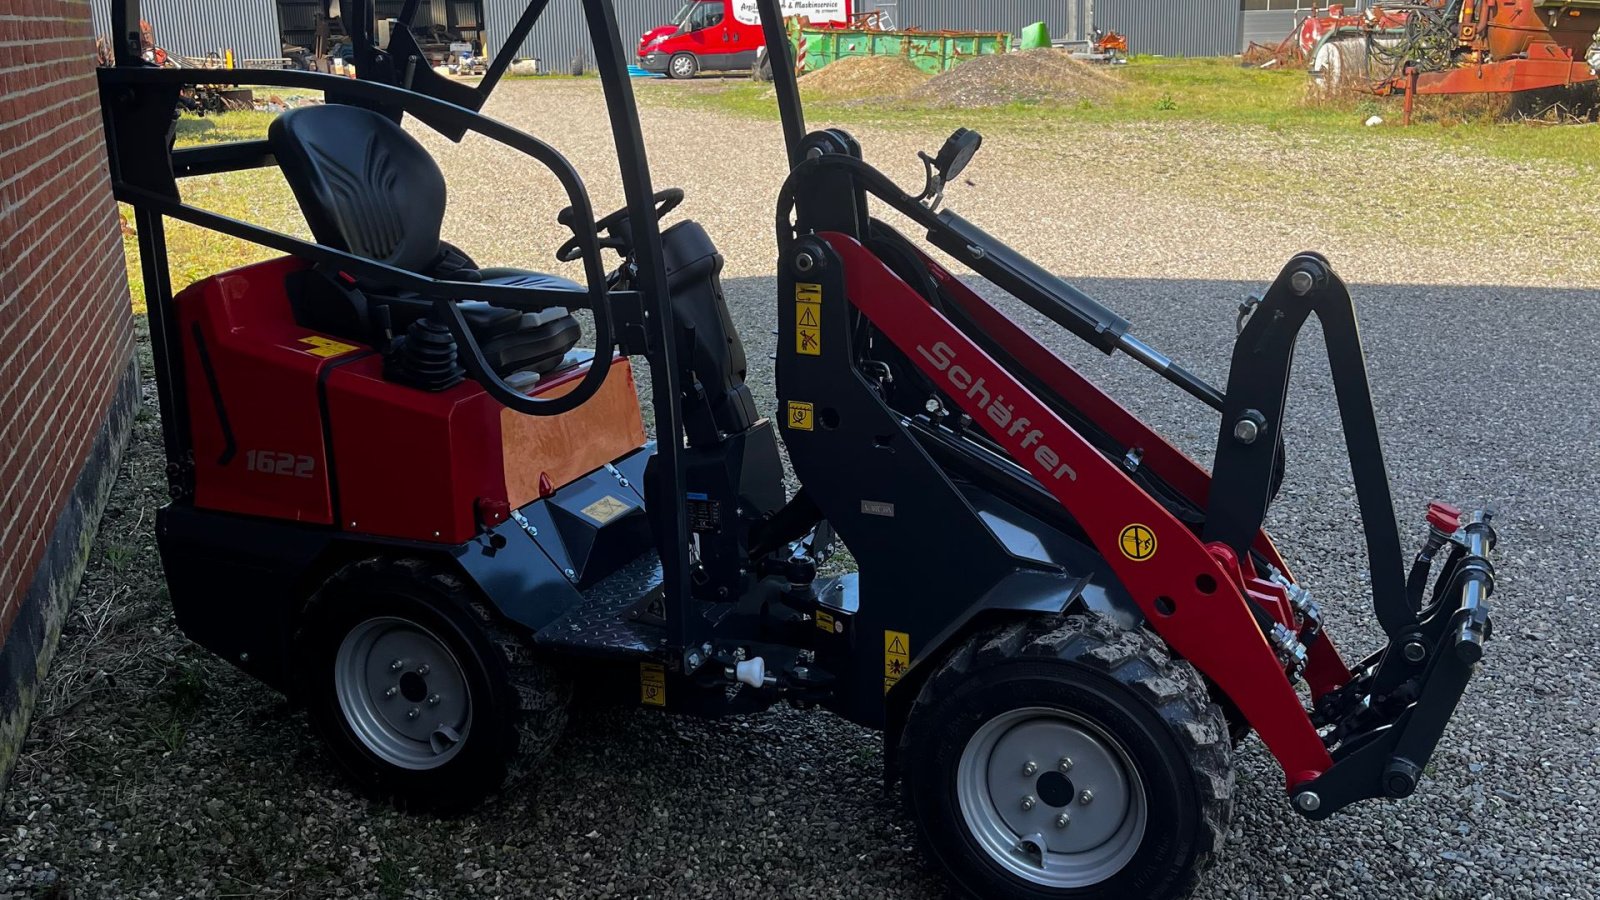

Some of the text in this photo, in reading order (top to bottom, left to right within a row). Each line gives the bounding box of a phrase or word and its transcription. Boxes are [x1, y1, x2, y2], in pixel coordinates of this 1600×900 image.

[795, 1, 838, 9] Maskinservice
[916, 341, 1077, 481] Schäffer
[246, 449, 315, 478] 1622
